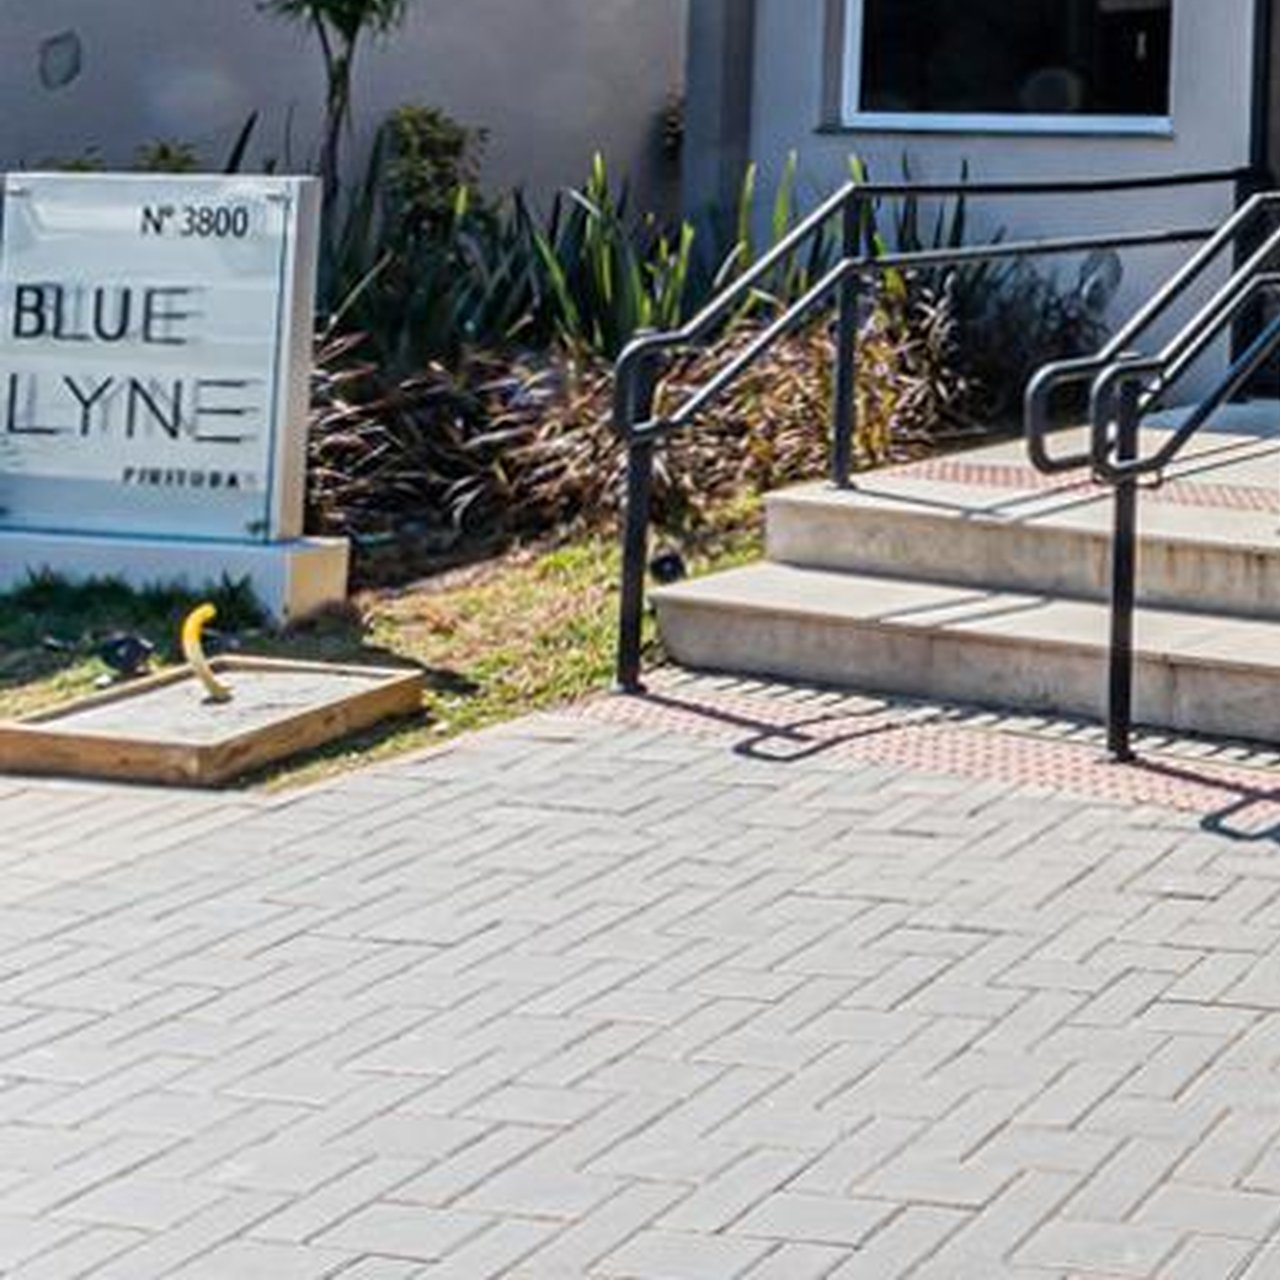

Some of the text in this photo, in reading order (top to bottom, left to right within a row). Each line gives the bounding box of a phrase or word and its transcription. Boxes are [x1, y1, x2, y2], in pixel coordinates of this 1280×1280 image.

[180, 204, 249, 238] 3800
[13, 282, 189, 346] BLUE
[6, 372, 247, 444] LYNE
